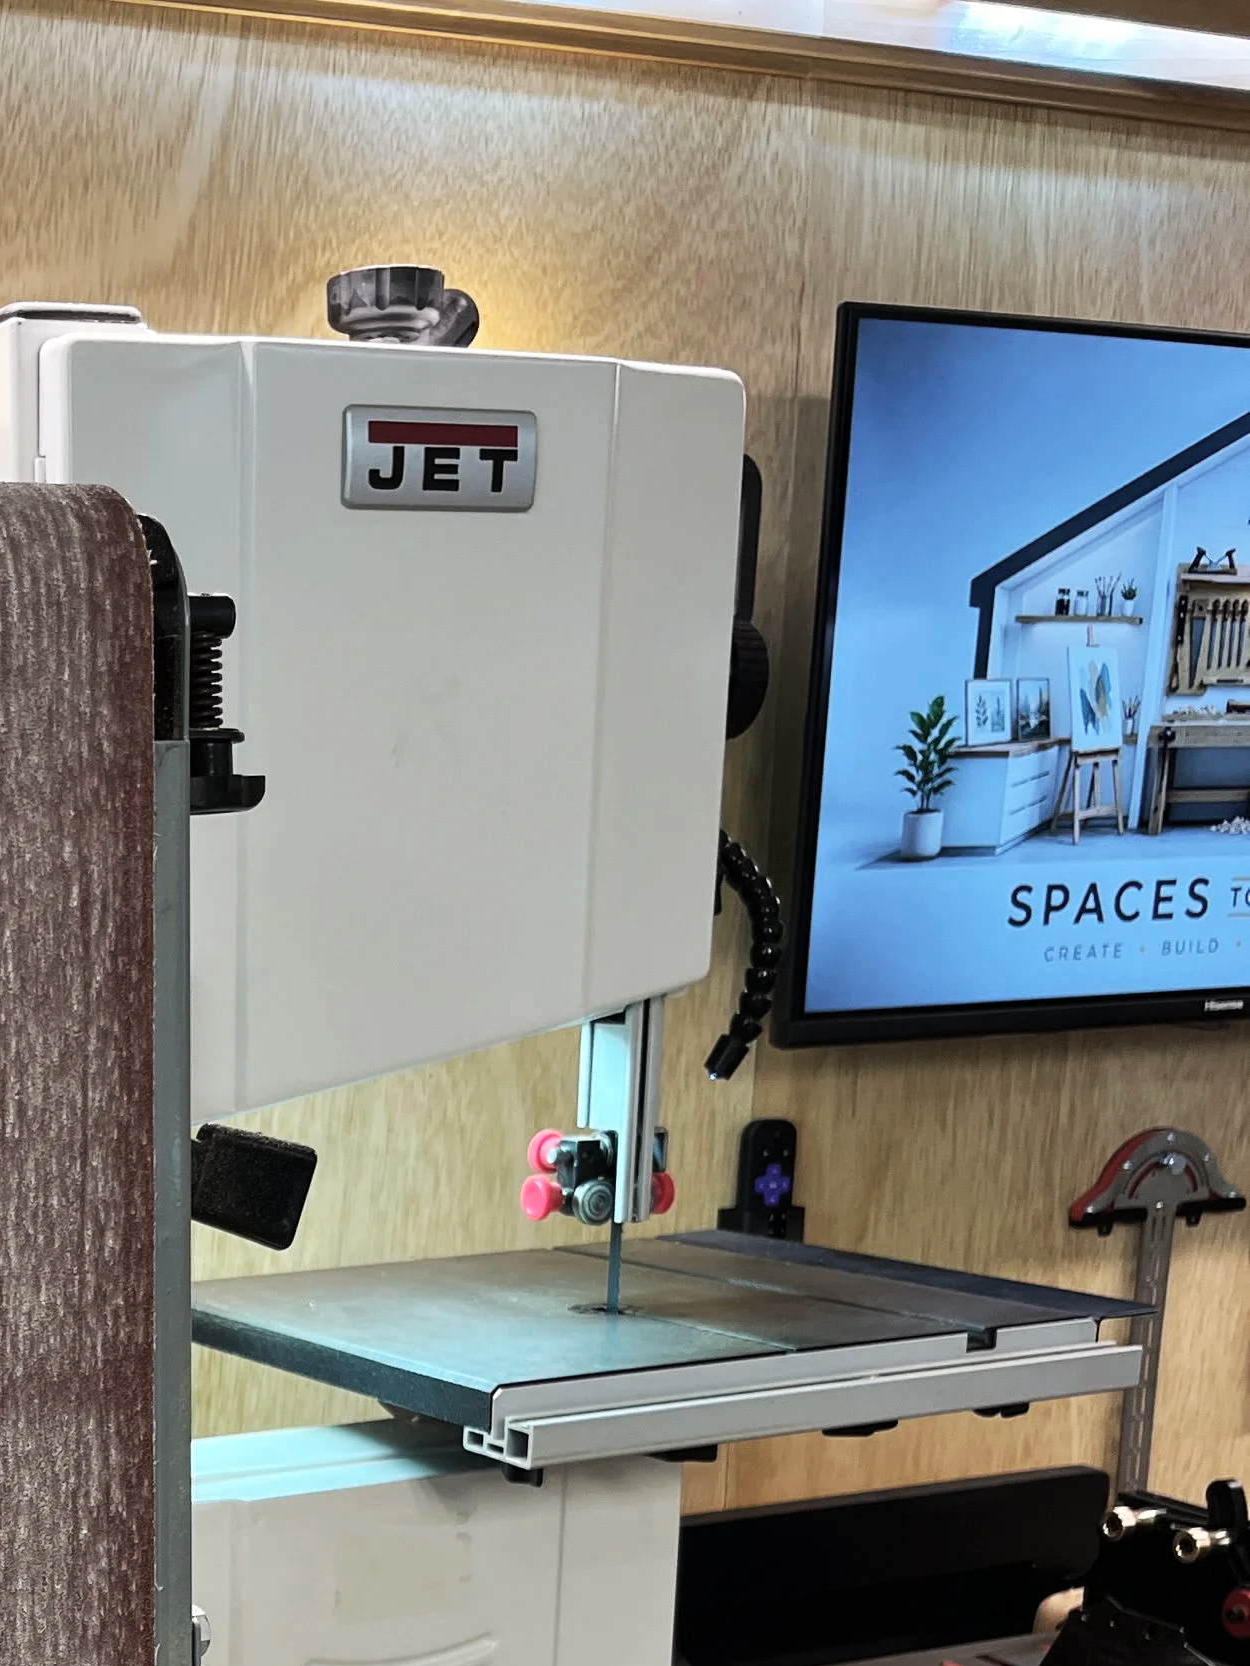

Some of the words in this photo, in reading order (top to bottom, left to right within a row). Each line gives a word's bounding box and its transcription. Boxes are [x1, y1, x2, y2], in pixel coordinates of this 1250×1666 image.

[368, 446, 518, 492] JET
[1008, 877, 1210, 927] SPACES
[1044, 942, 1123, 963] CREATE
[1161, 937, 1219, 957] BUILD
